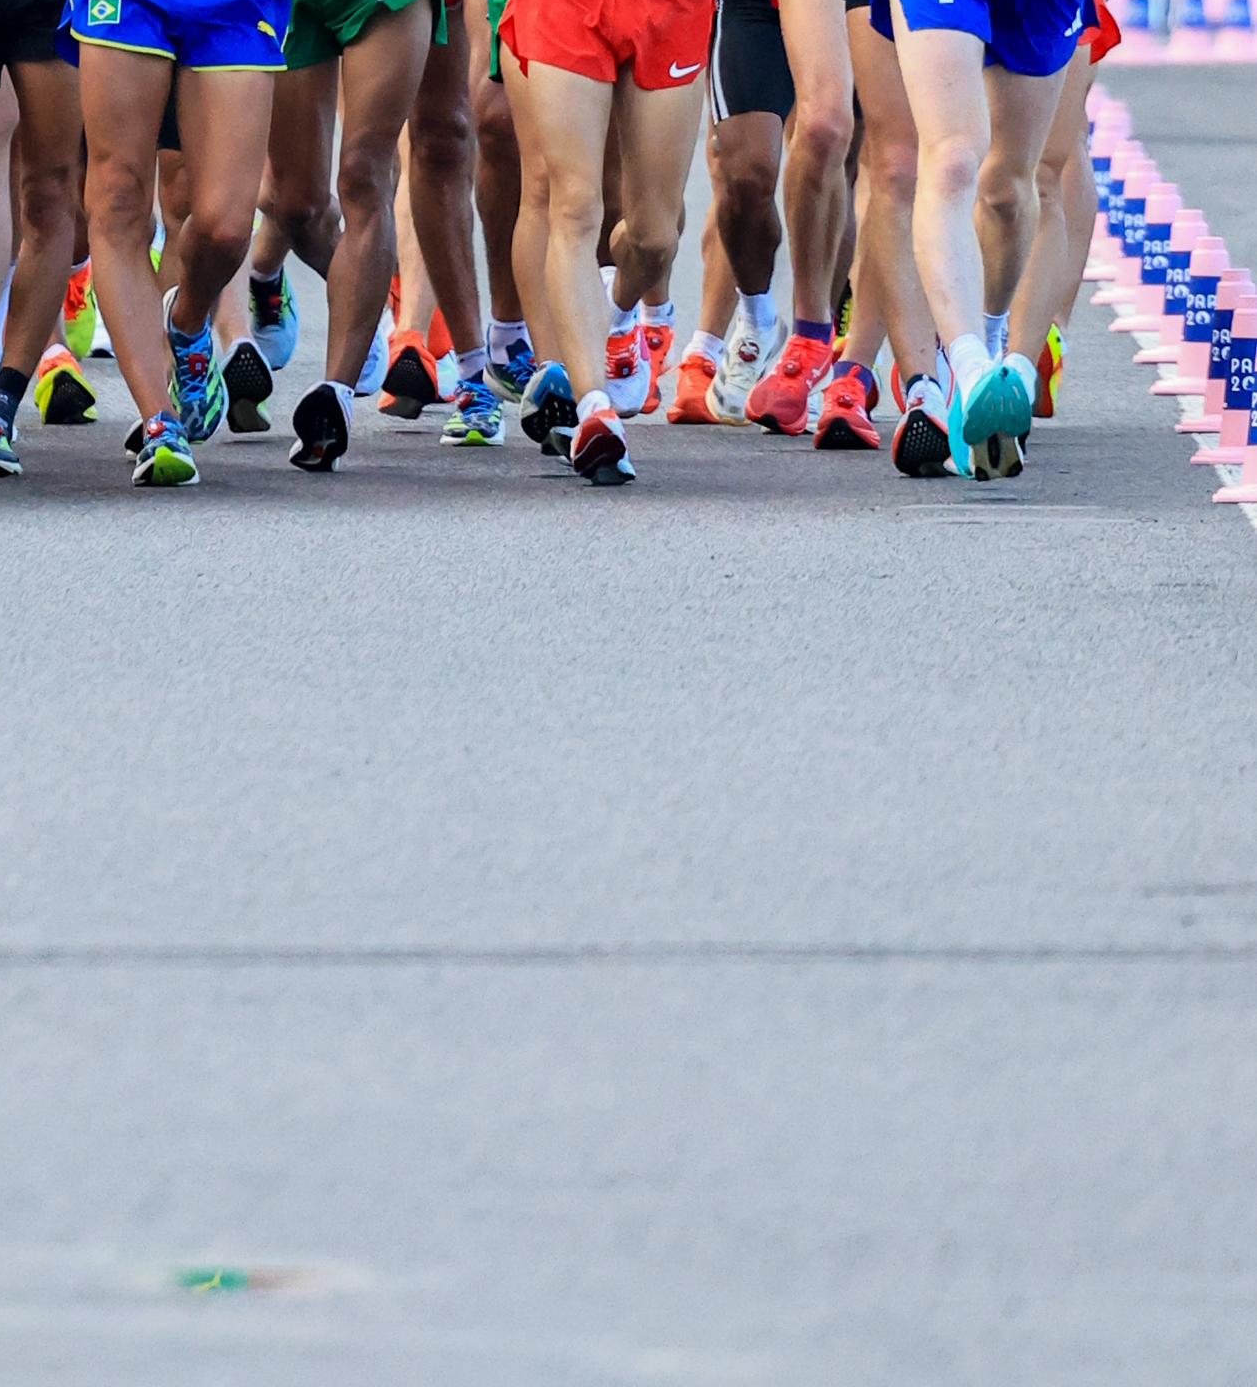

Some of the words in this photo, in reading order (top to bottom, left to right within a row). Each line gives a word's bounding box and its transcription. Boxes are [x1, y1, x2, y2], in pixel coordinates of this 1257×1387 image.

[1143, 240, 1170, 254] PAR
[1143, 256, 1170, 270] 20
[1166, 268, 1191, 283] PAR
[1165, 284, 1190, 300] 20
[1186, 294, 1216, 309] PAR
[1186, 310, 1211, 326] 20
